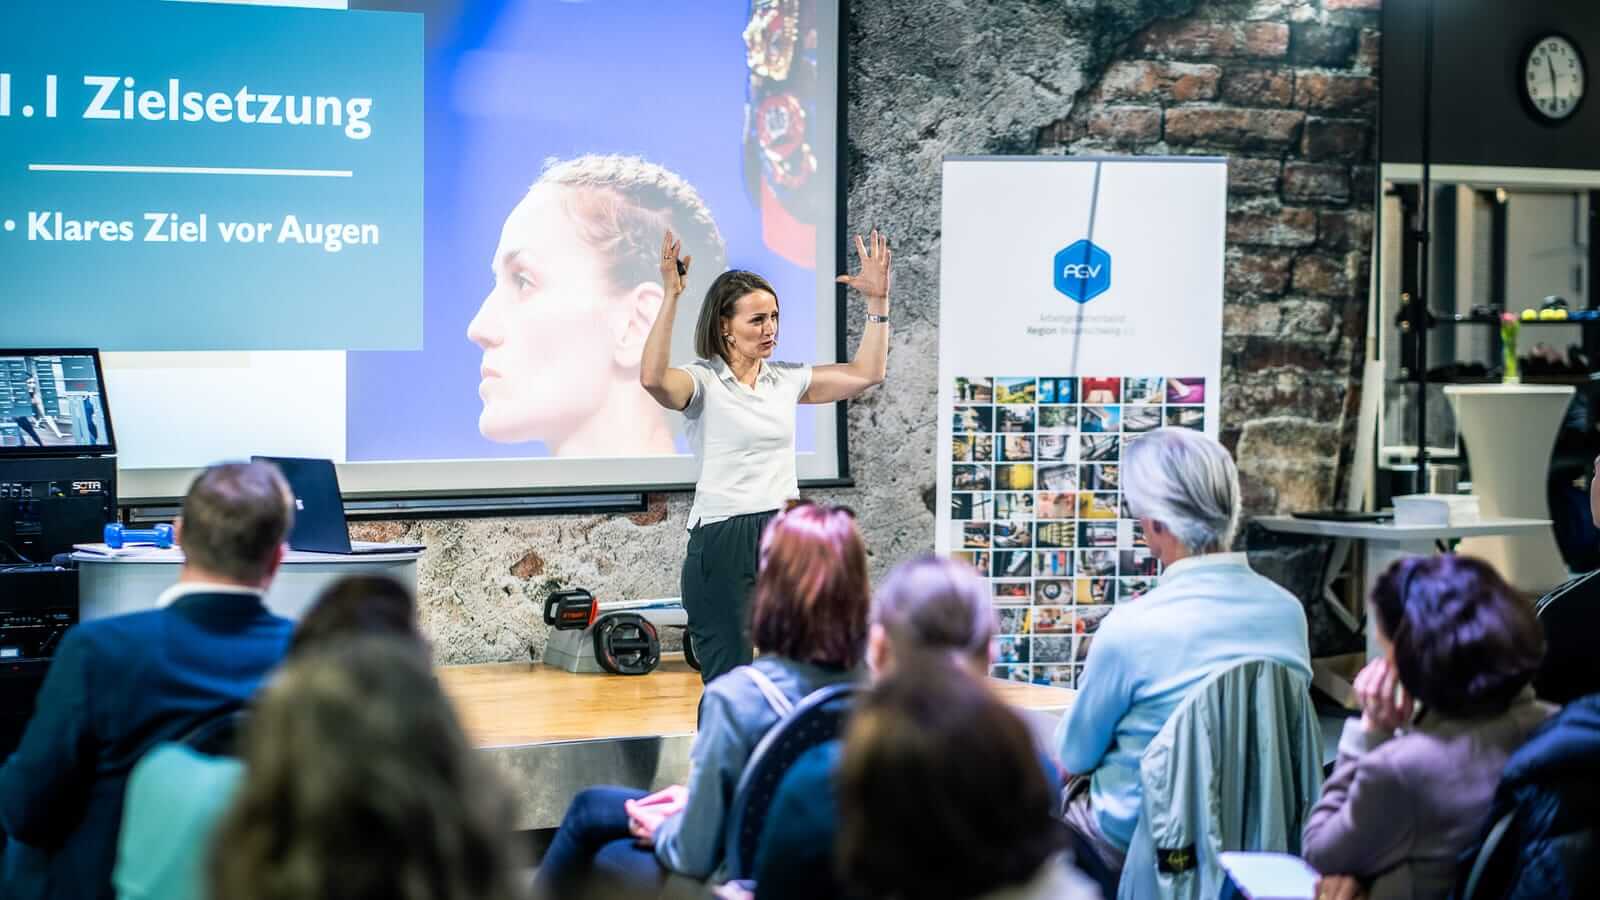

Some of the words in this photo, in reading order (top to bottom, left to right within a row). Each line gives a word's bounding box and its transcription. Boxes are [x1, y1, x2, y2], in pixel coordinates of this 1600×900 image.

[83, 75, 373, 140] Zielsetzung
[28, 212, 134, 241] Klares
[144, 213, 207, 242] Ziel
[218, 222, 273, 243] vor
[277, 214, 379, 253] Augen
[1064, 264, 1102, 279] AGV
[1027, 326, 1056, 337] Region
